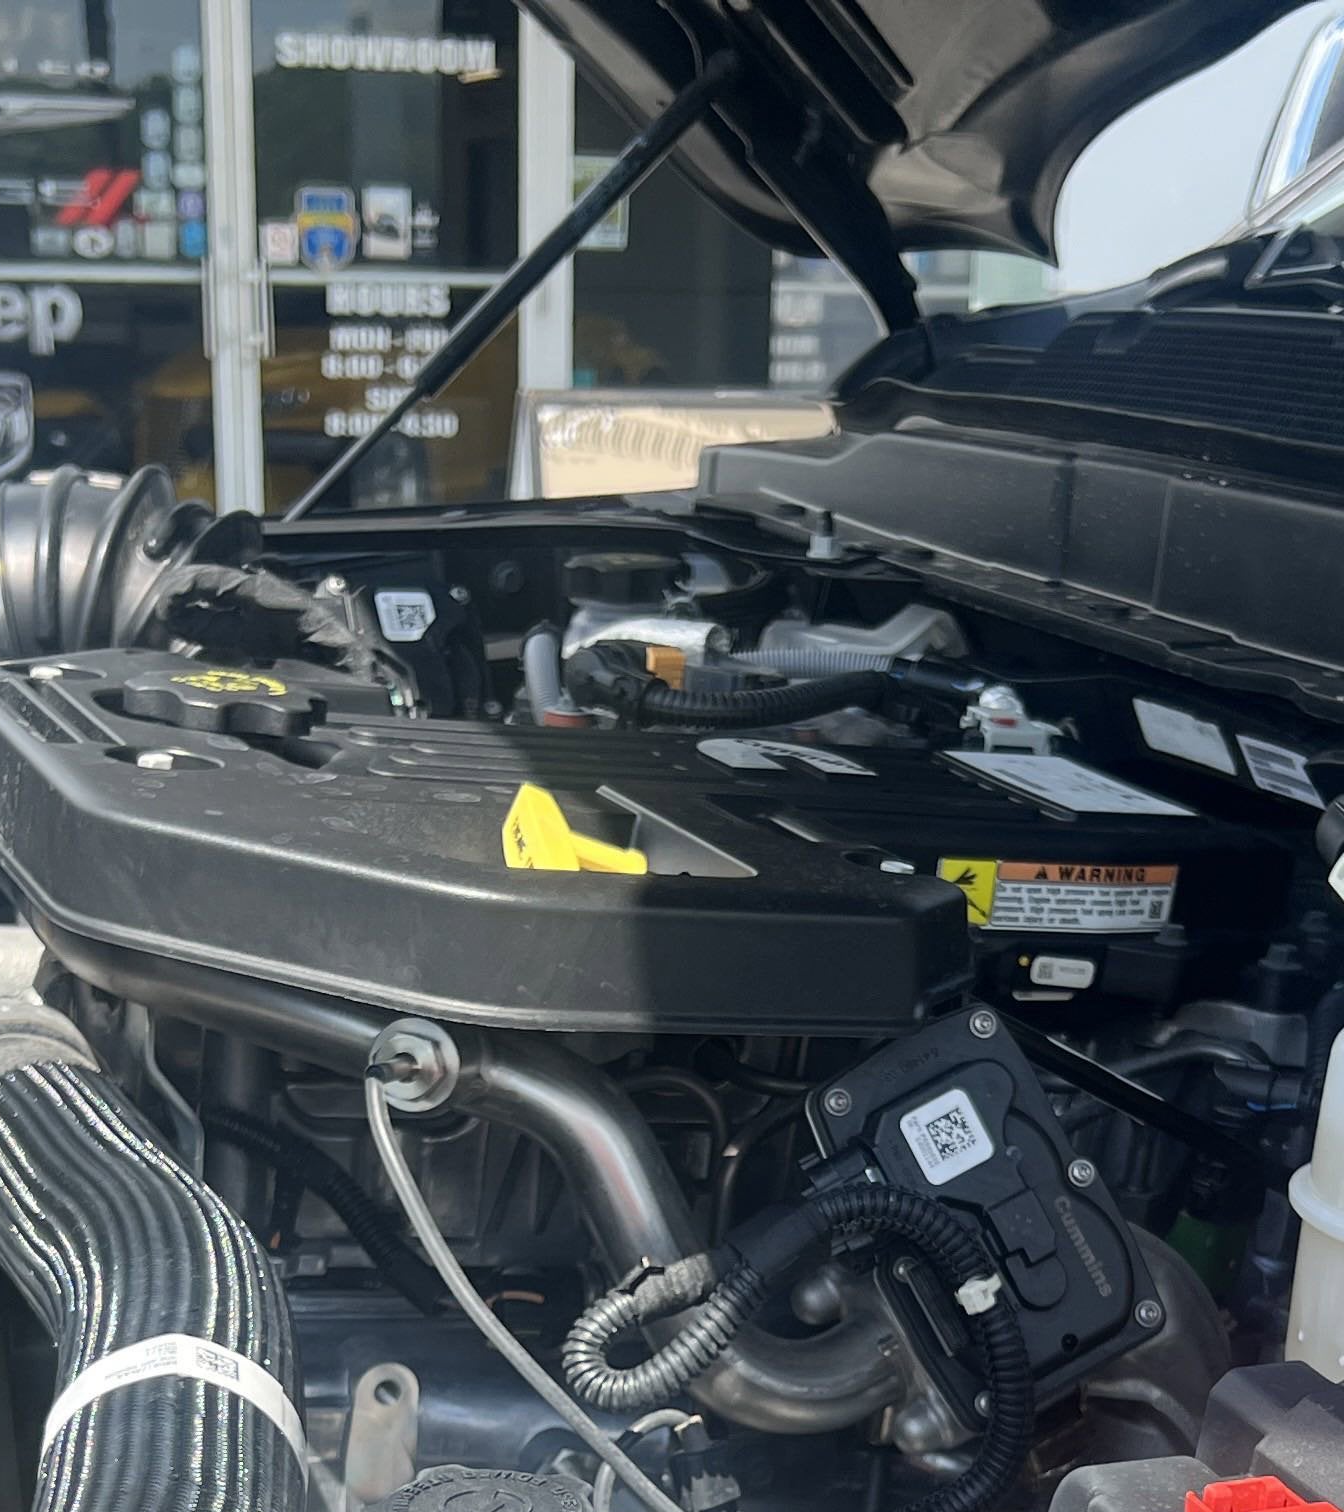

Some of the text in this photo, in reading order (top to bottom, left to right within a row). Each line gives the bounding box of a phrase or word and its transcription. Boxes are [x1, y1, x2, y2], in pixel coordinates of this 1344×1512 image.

[274, 33, 496, 74] SHOWROOM
[325, 282, 451, 317] HOURS
[1059, 866, 1145, 882] WARNING
[1056, 1195, 1112, 1297] Cummins
